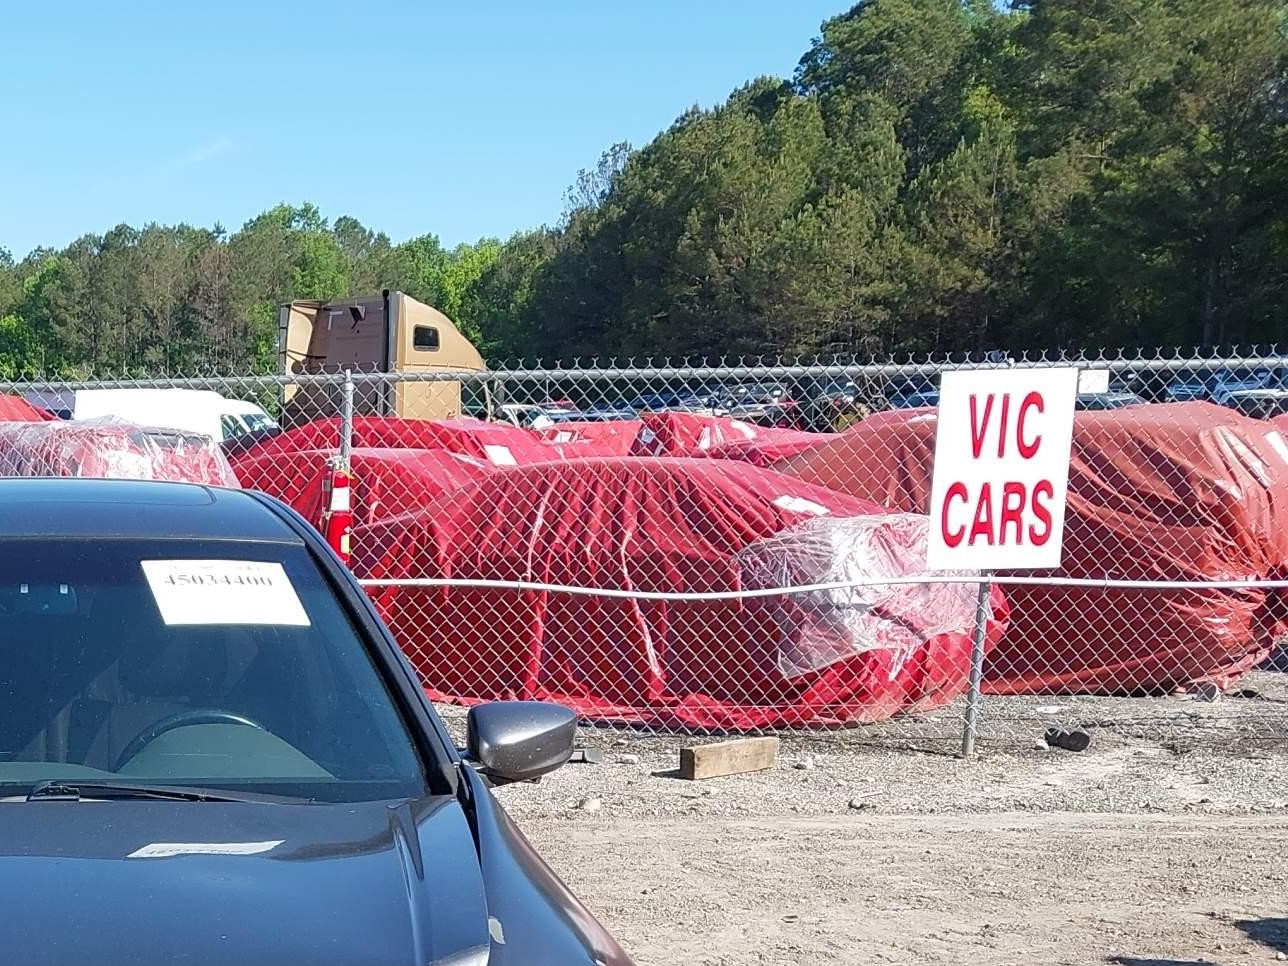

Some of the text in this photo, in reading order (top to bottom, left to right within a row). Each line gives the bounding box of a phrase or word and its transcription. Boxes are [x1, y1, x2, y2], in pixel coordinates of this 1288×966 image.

[969, 391, 1045, 459] VIC
[941, 479, 1054, 548] CARS
[164, 574, 273, 586] 45034400
